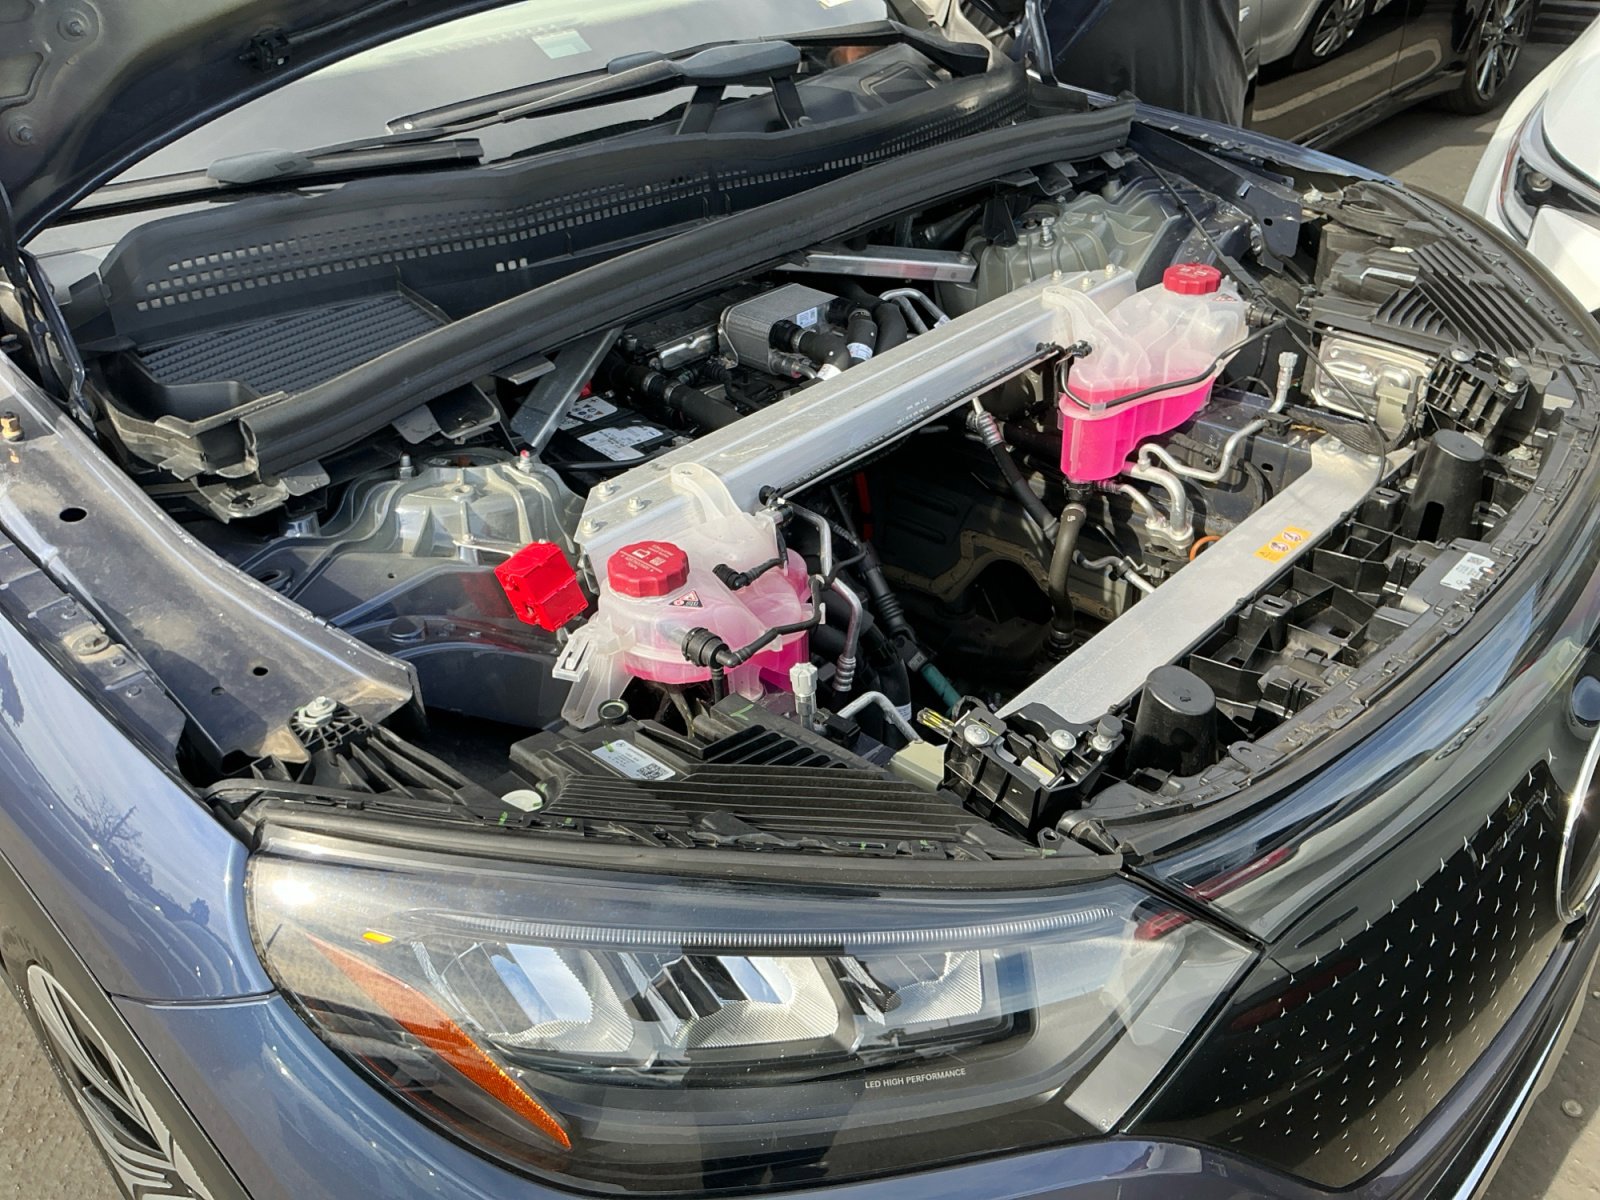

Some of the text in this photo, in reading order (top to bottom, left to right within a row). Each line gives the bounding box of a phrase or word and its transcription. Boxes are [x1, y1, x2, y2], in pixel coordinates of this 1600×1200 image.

[865, 1068, 966, 1089] LED HIGH PERFORMANCE
